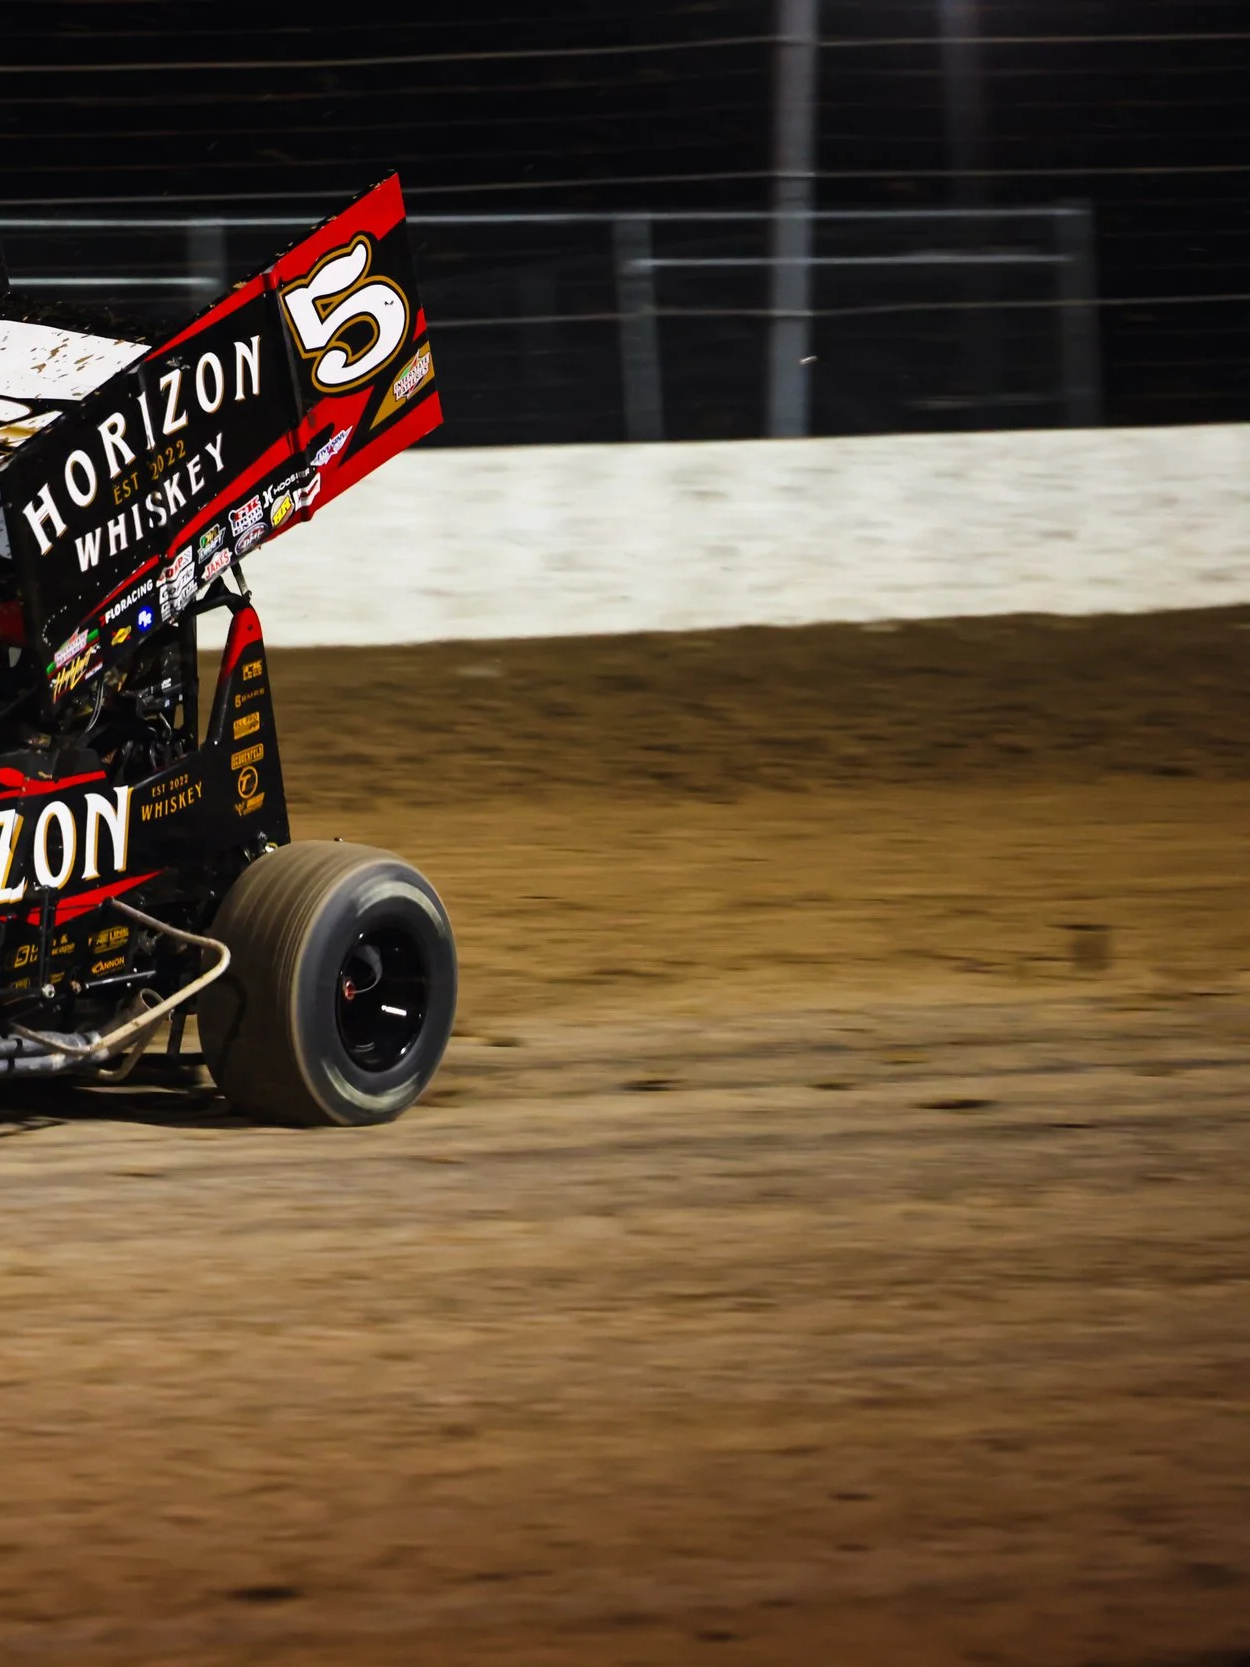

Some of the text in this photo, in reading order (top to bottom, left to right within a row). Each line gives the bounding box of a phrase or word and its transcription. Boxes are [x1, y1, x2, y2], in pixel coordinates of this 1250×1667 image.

[280, 236, 409, 392] 5
[394, 356, 429, 391] INTERSTATE
[23, 335, 261, 555] HORIZON
[113, 440, 186, 506] EST 2022
[74, 432, 226, 573] WHISKEY
[104, 579, 153, 624] FLORACING
[141, 781, 202, 821] WHISKEY
[152, 774, 188, 797] EST 2022
